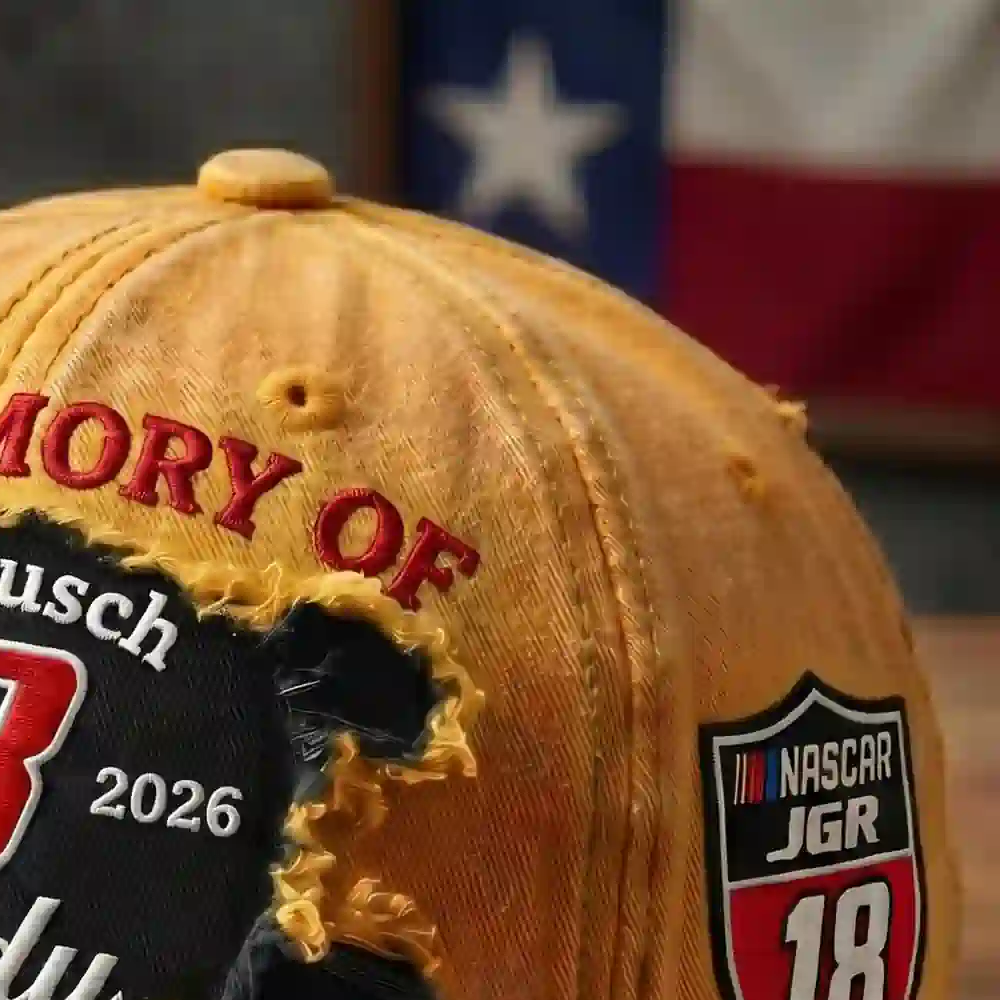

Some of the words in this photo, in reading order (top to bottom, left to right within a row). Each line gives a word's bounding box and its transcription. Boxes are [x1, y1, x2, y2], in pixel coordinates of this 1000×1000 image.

[312, 487, 481, 612] OF
[780, 731, 892, 798] NASCAR
[89, 766, 244, 838] 2026
[766, 795, 880, 863] JGR
